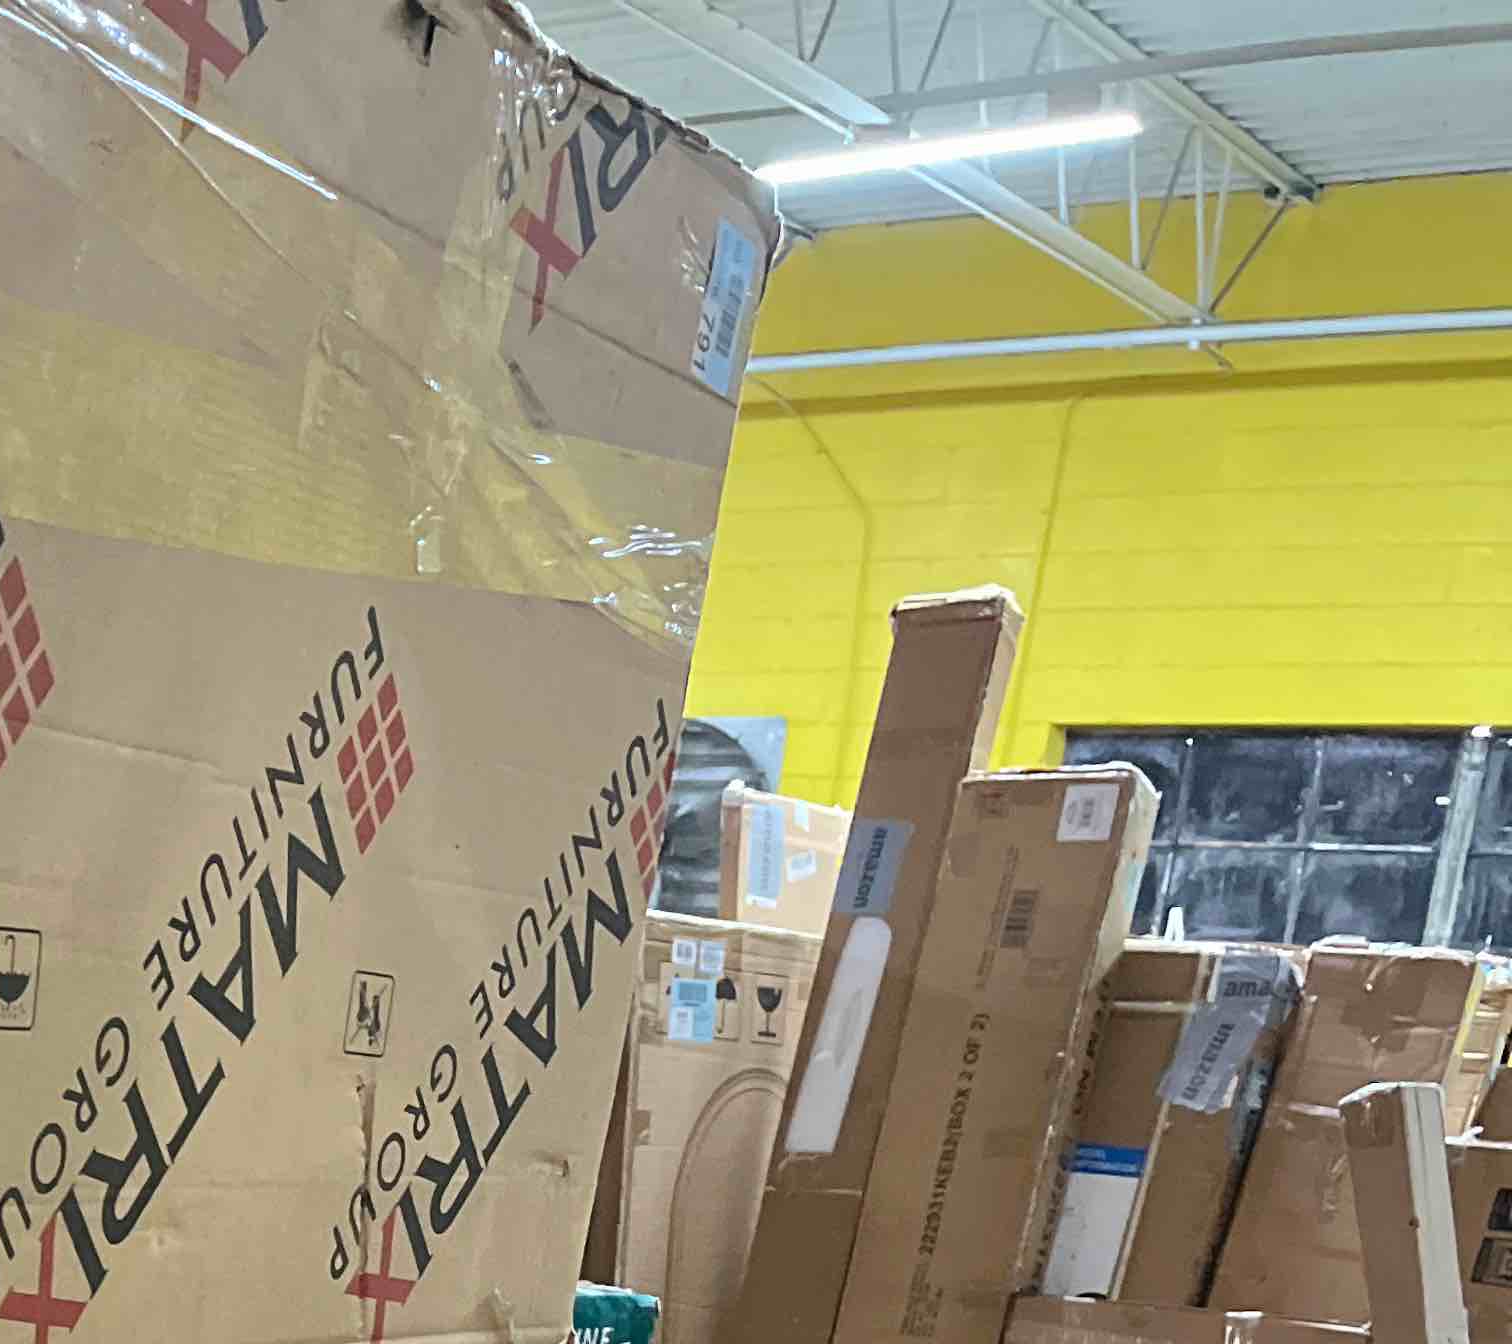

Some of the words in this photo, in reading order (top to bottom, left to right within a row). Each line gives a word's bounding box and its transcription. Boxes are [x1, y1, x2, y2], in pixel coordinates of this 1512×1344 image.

[142, 605, 386, 1010] FURNITURE
[468, 698, 670, 1040] FURNITURE
[329, 1043, 458, 1280] GROUP
